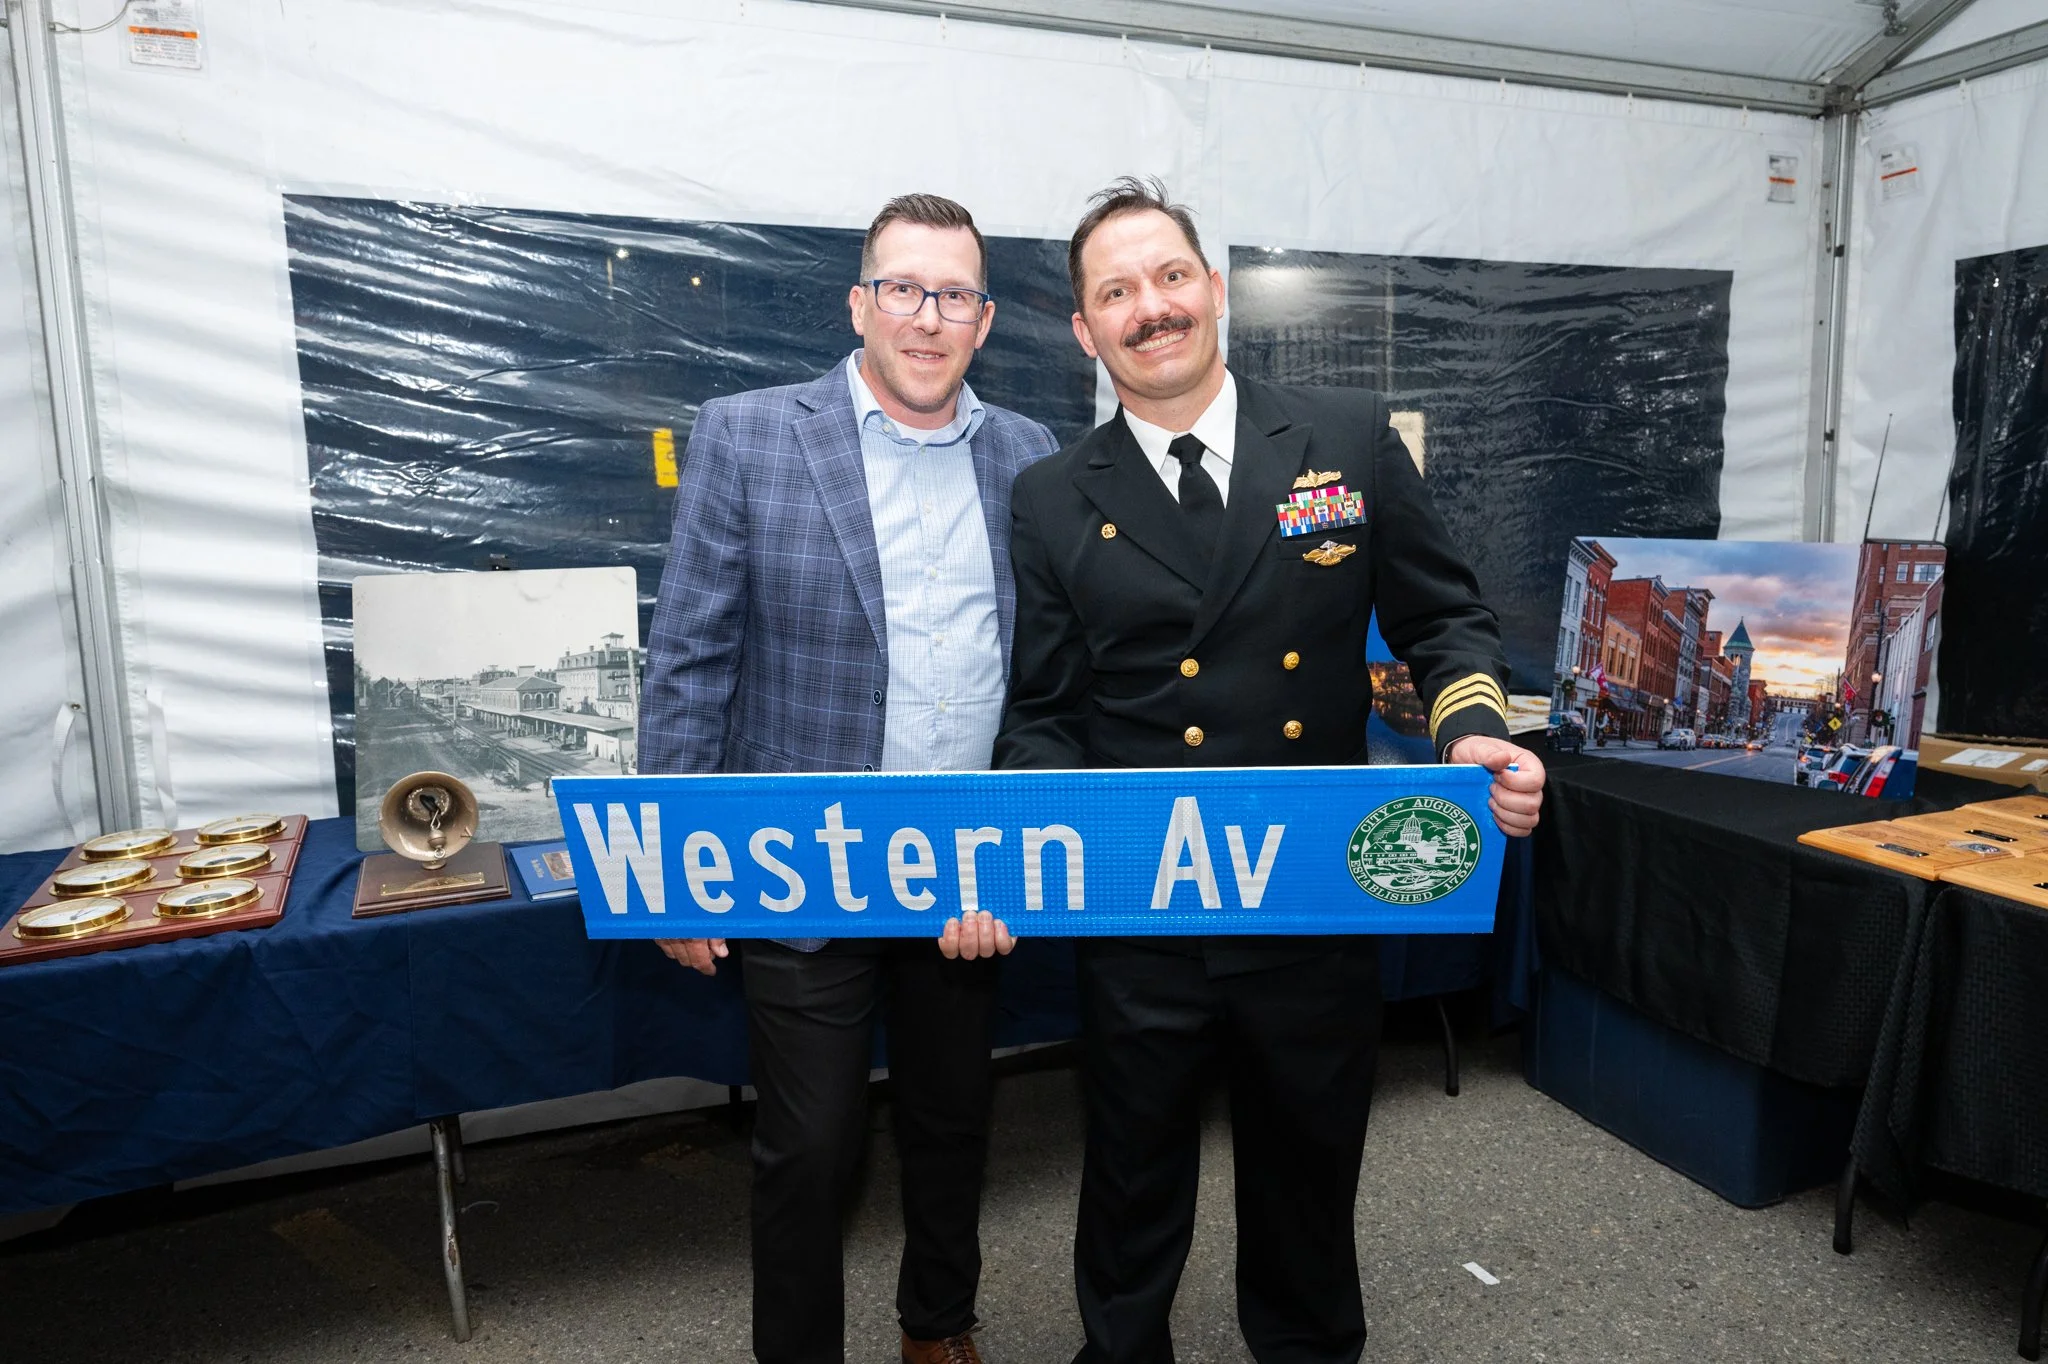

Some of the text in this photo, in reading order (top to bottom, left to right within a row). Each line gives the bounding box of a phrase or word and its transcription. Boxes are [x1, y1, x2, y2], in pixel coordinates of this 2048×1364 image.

[1360, 798, 1472, 833] CITY OF AUGUSTA
[573, 796, 1286, 914] Western Av
[1350, 859, 1474, 902] ESTABLISHED 1754
